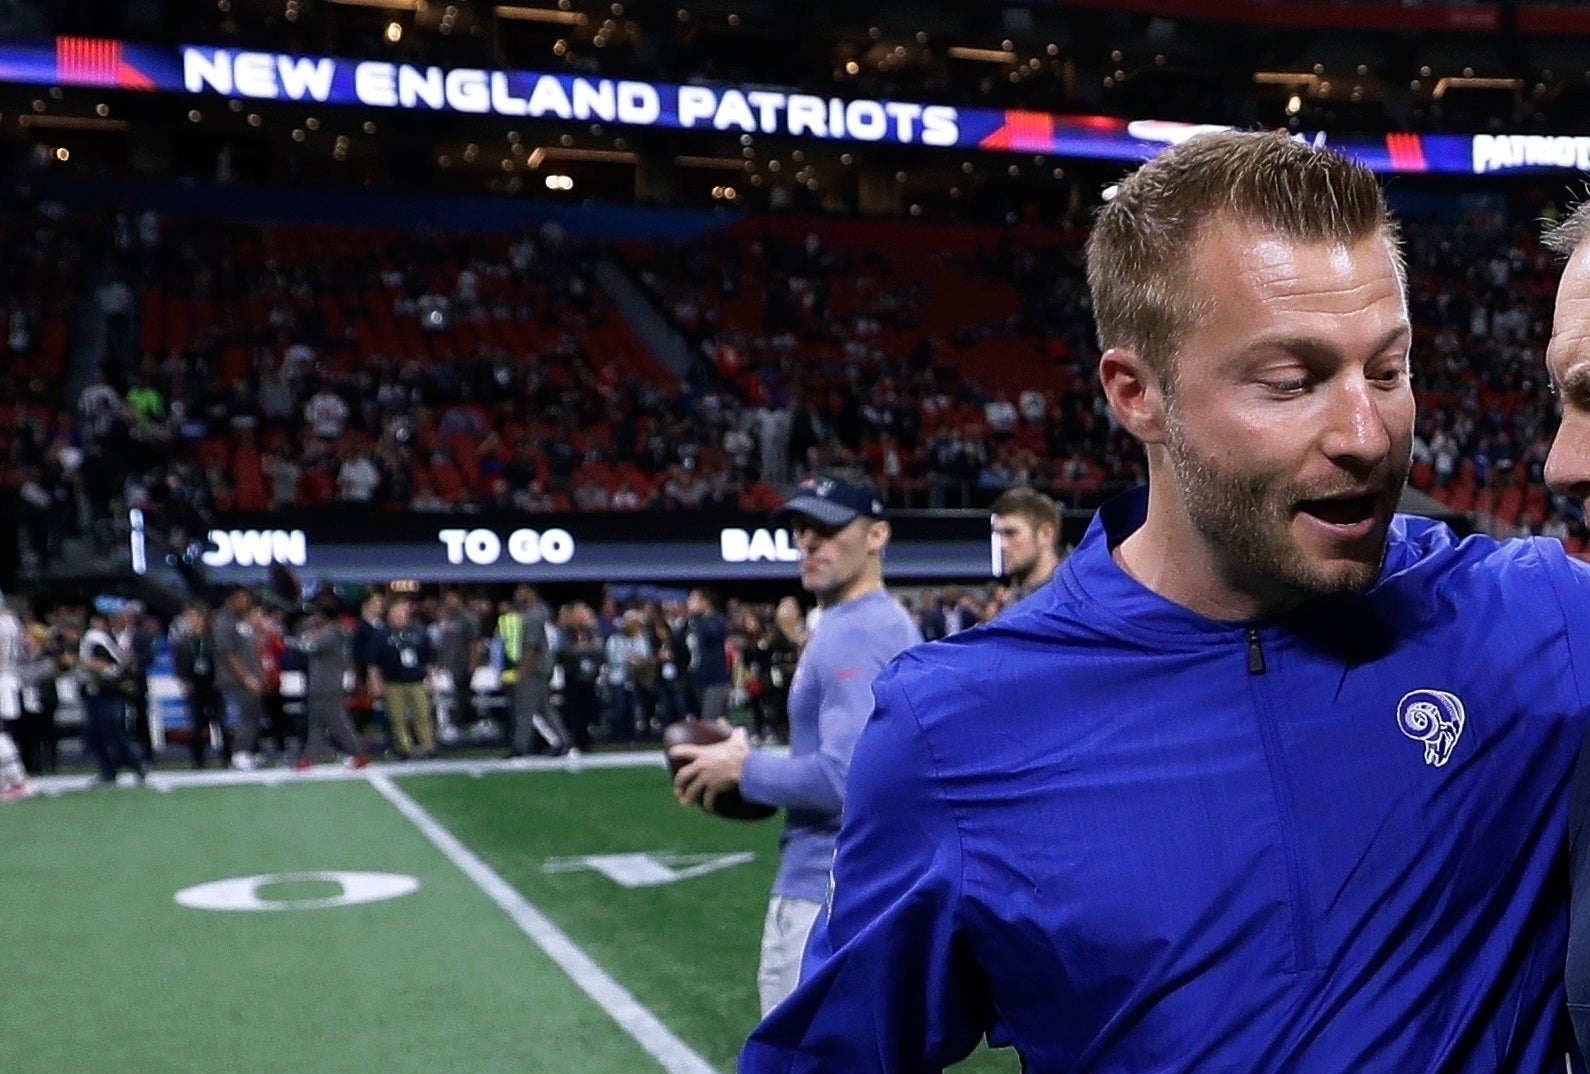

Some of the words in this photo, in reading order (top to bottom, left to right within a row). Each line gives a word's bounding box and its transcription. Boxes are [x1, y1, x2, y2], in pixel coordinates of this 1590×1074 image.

[183, 48, 335, 101] NEW
[354, 61, 660, 125] ENGLAND
[677, 84, 959, 147] PATRIOTS
[201, 529, 307, 567] OWN
[438, 528, 501, 565] TO
[508, 528, 575, 565] GO
[720, 528, 801, 563] BAL
